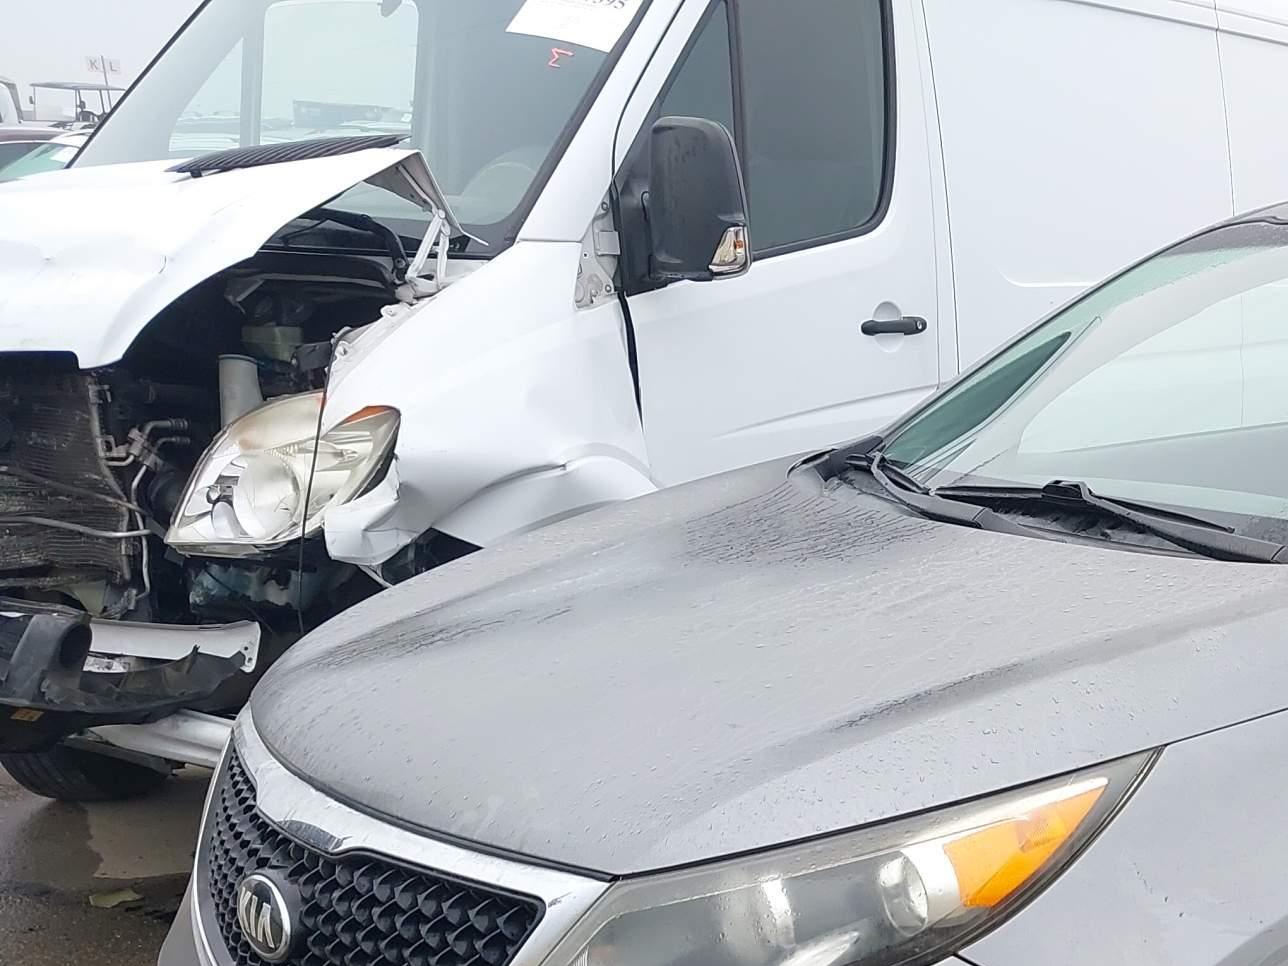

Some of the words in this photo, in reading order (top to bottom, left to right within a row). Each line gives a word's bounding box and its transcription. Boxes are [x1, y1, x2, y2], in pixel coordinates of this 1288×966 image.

[89, 58, 99, 70] K
[109, 60, 118, 72] L
[239, 886, 276, 950] KIA
